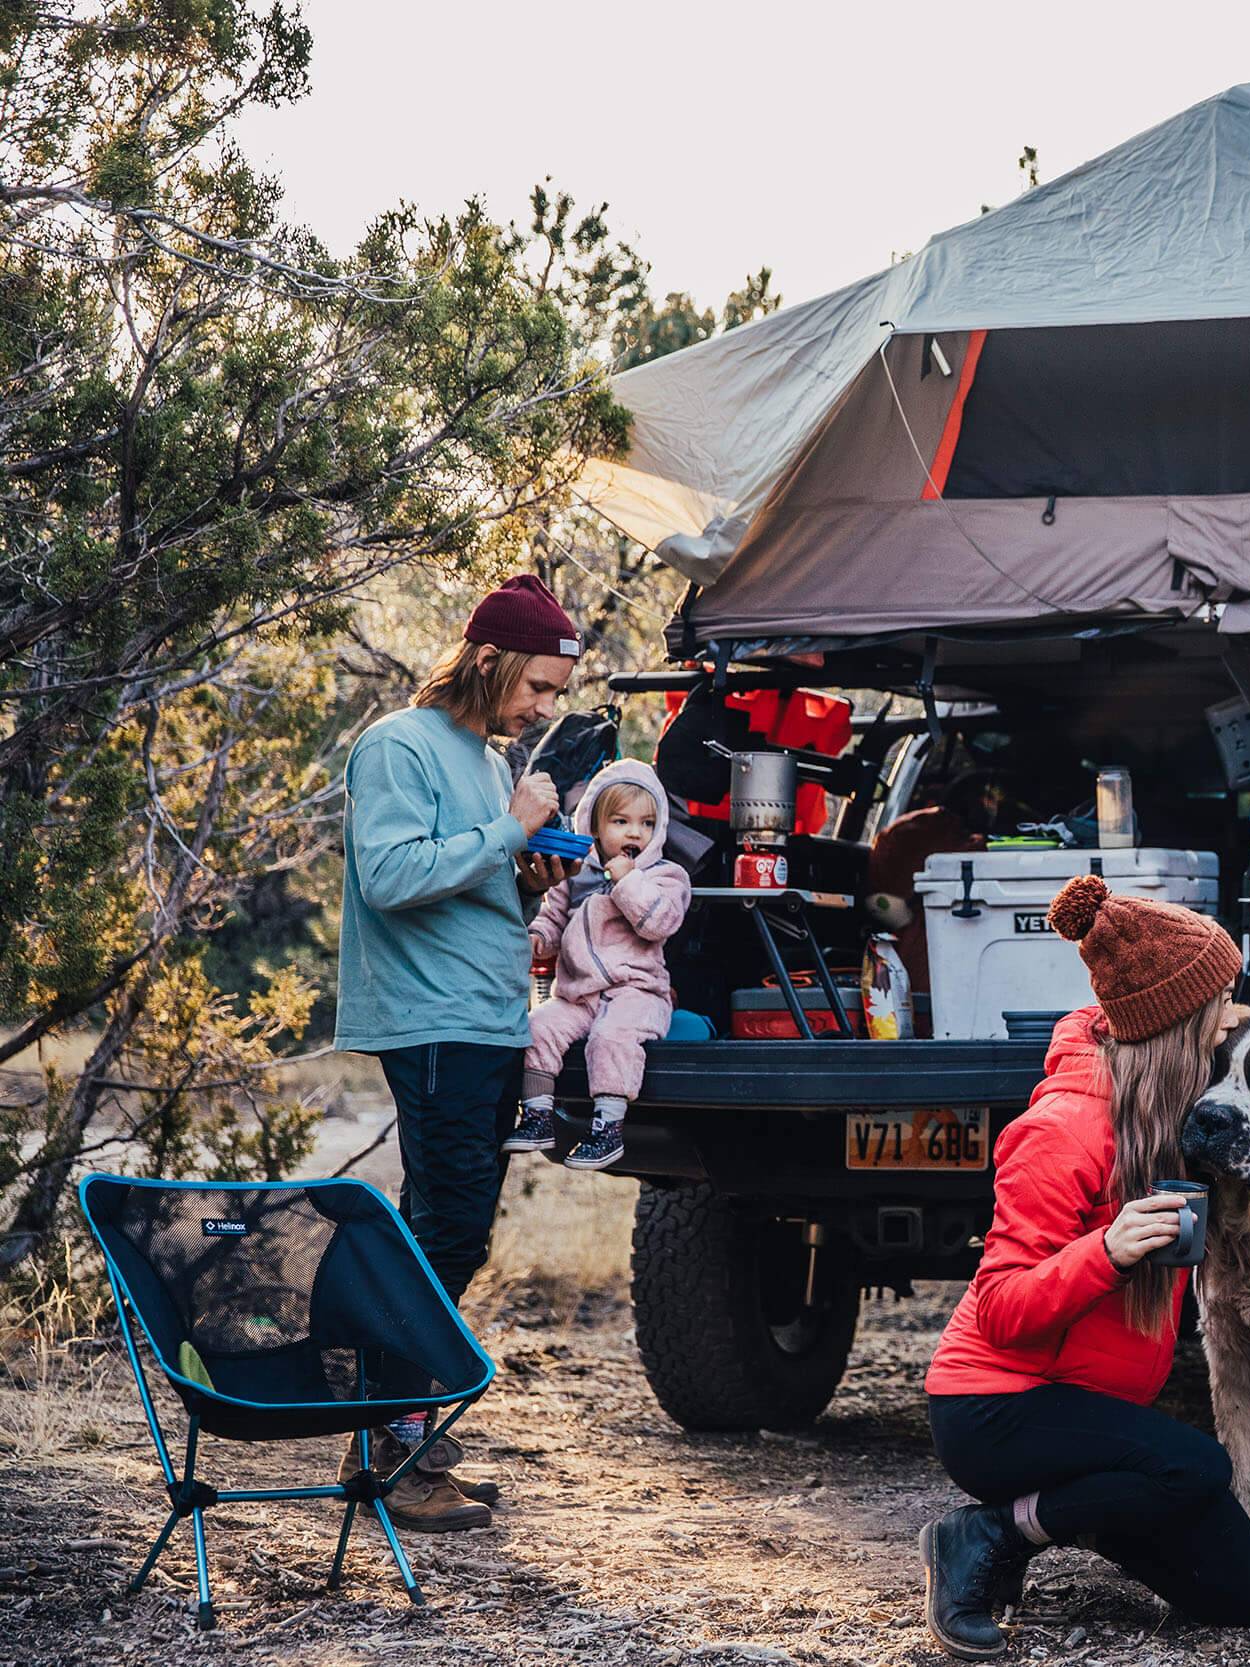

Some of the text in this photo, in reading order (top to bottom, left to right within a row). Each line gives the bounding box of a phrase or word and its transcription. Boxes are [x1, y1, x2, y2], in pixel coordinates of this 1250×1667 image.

[1016, 916, 1050, 931] YET
[855, 1122, 904, 1161] V71
[217, 1221, 246, 1231] Helinox
